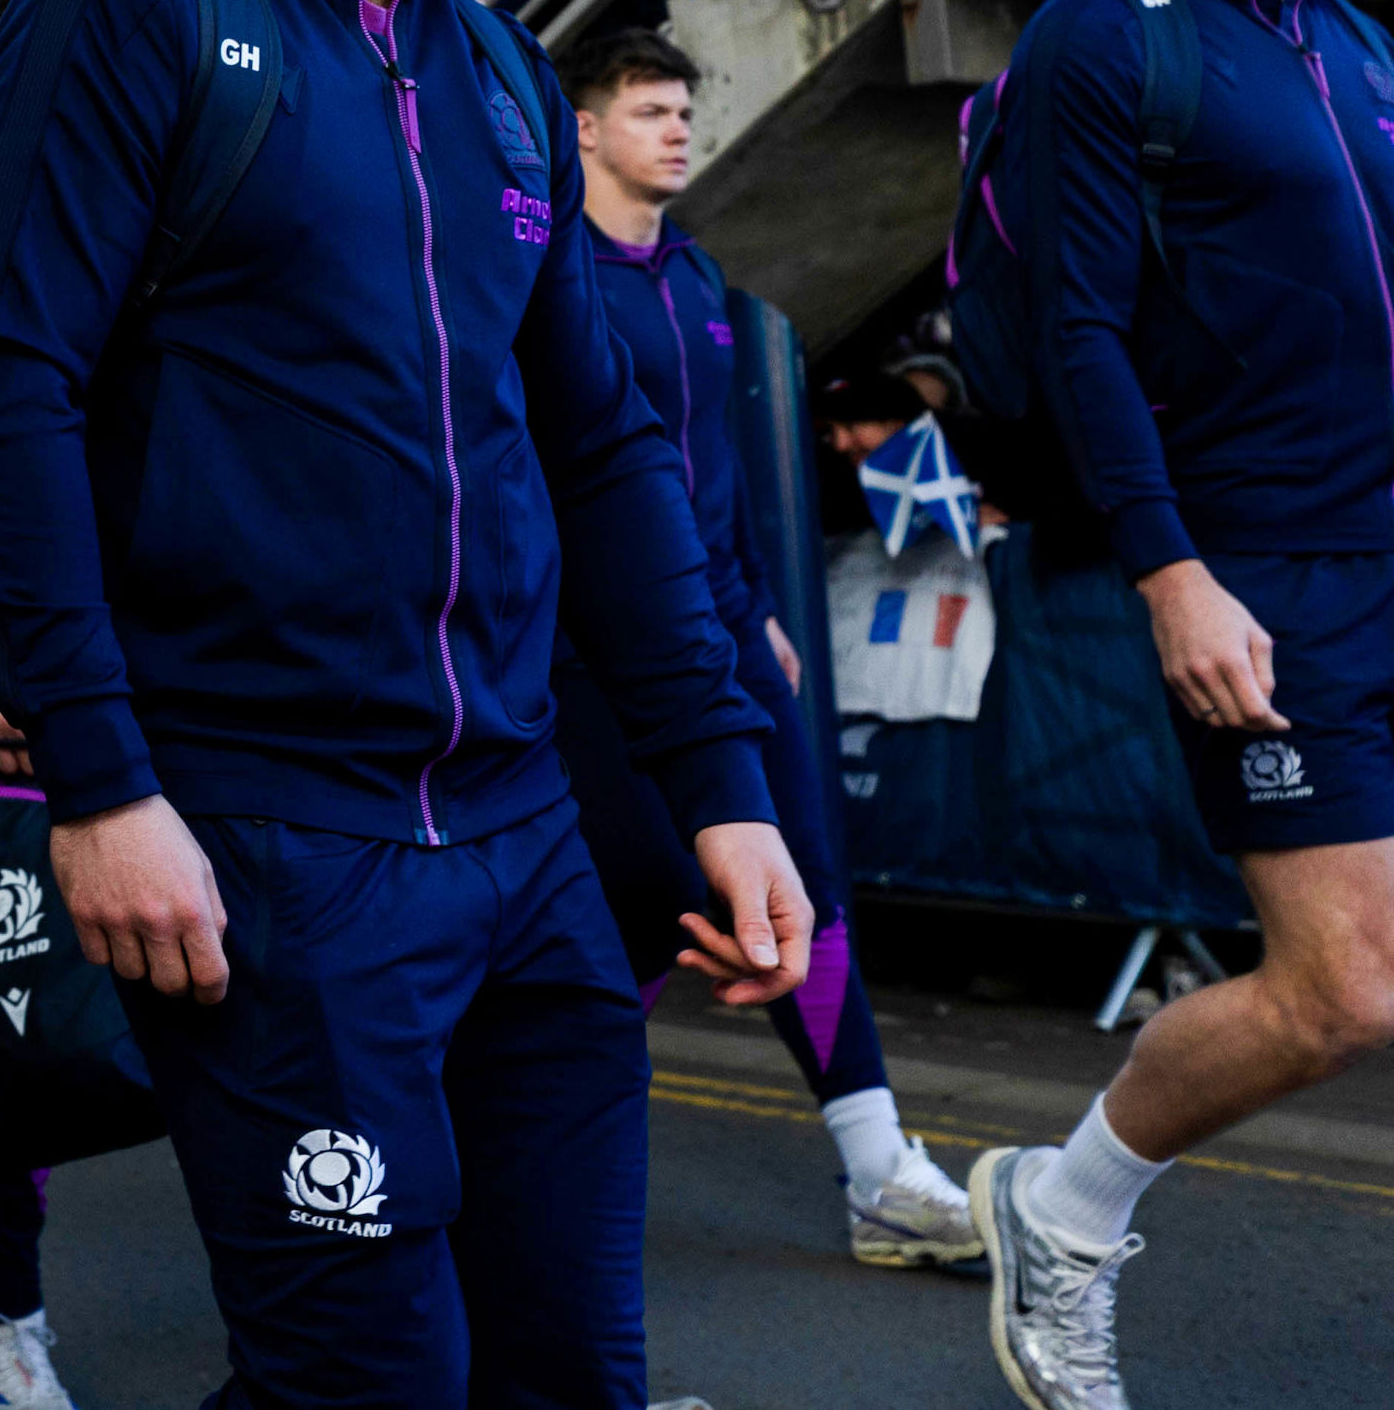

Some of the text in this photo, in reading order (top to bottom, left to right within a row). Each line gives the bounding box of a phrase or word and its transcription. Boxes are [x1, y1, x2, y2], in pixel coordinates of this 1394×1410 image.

[220, 38, 261, 72] GH
[500, 188, 552, 224] Arno
[289, 1209, 393, 1238] SCOTLAND
